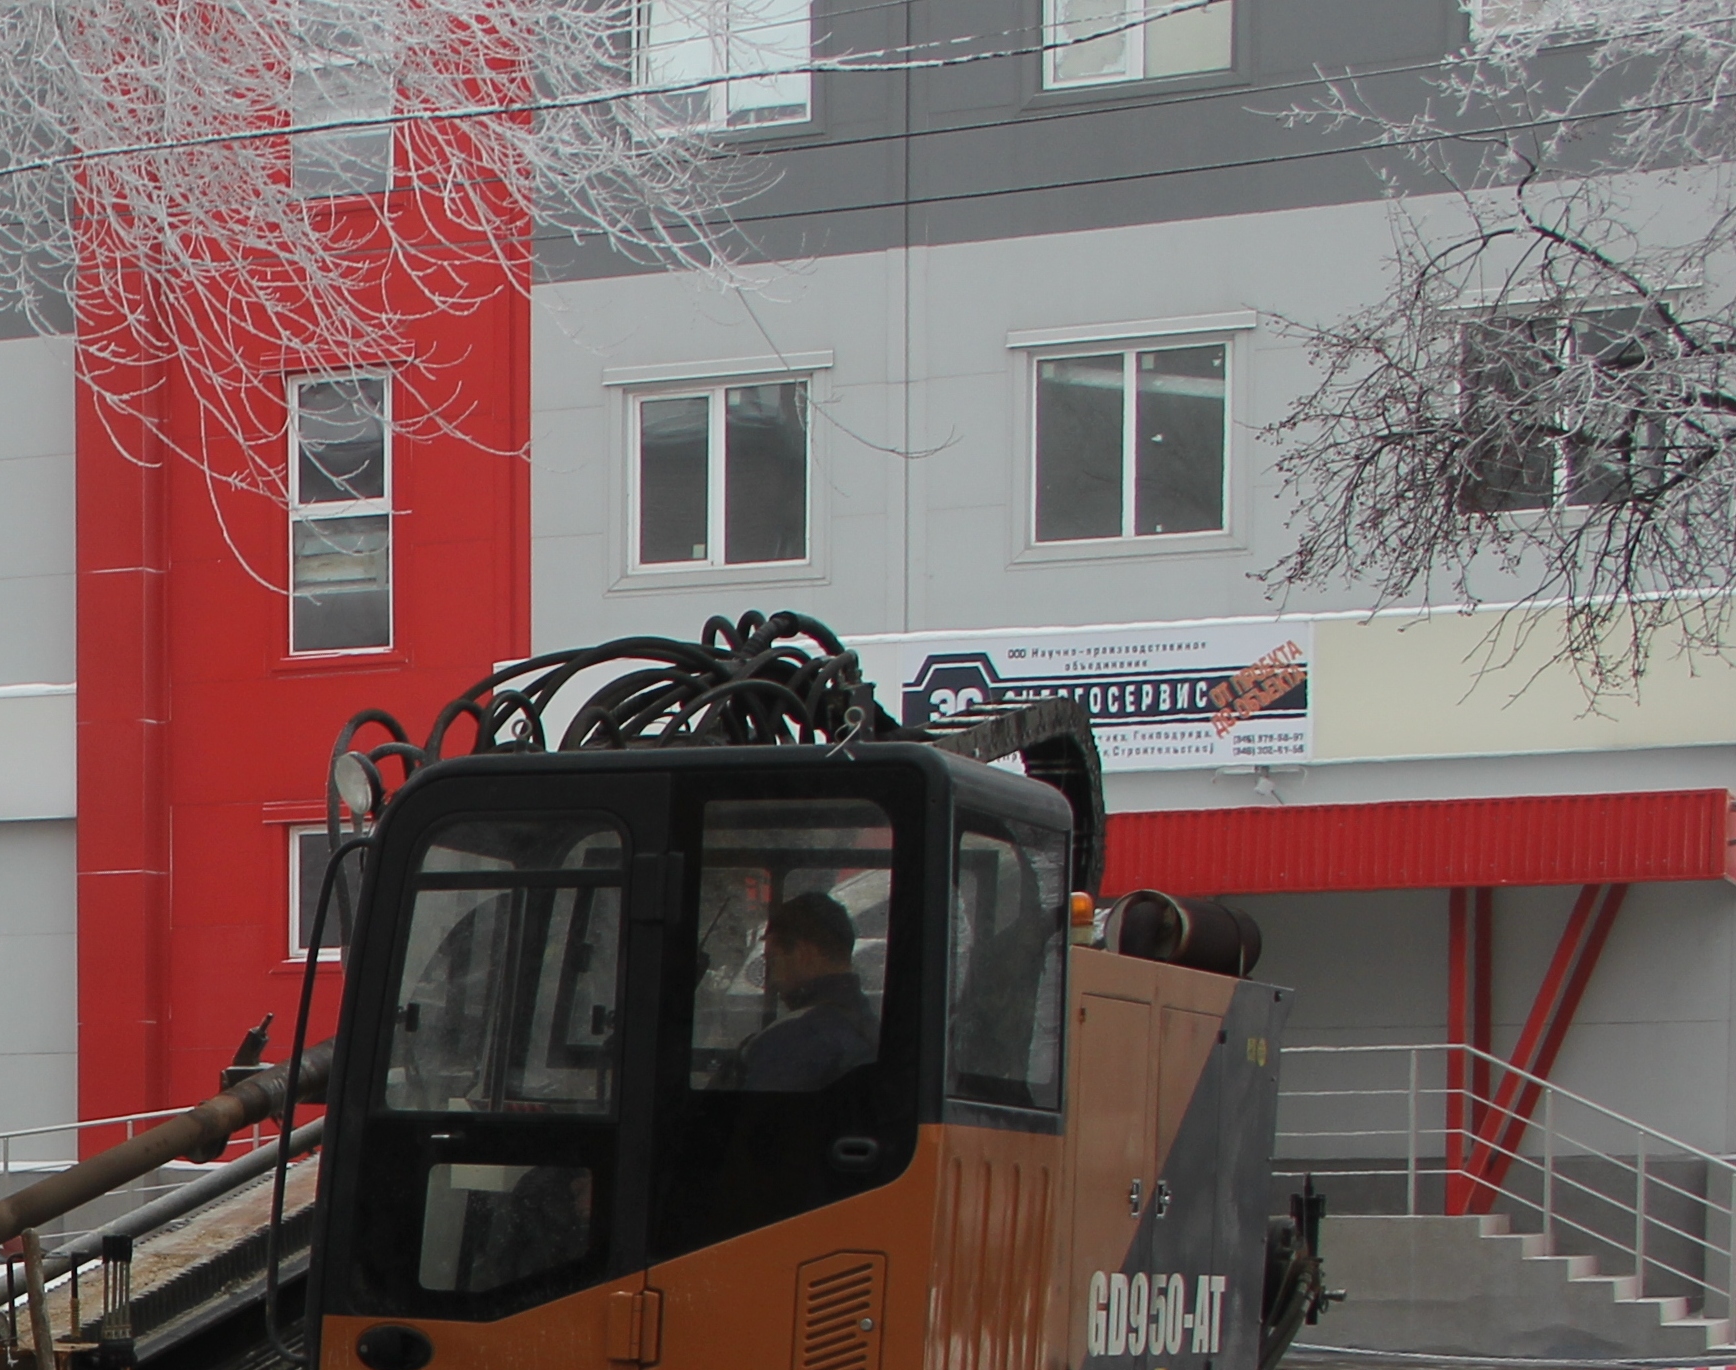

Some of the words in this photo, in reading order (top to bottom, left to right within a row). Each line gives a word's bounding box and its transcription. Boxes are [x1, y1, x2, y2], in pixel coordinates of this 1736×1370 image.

[1007, 648, 1027, 659] ООО
[1031, 642, 1207, 660] Научно-производственное
[1064, 660, 1148, 671] объединение
[1209, 682, 1235, 708] ОТ
[1230, 640, 1303, 695] ПРОЕКТА
[1212, 708, 1237, 739] ДО
[1234, 665, 1306, 718] ОБЪЕКТА
[1088, 1270, 1226, 1357] GD950-AT
